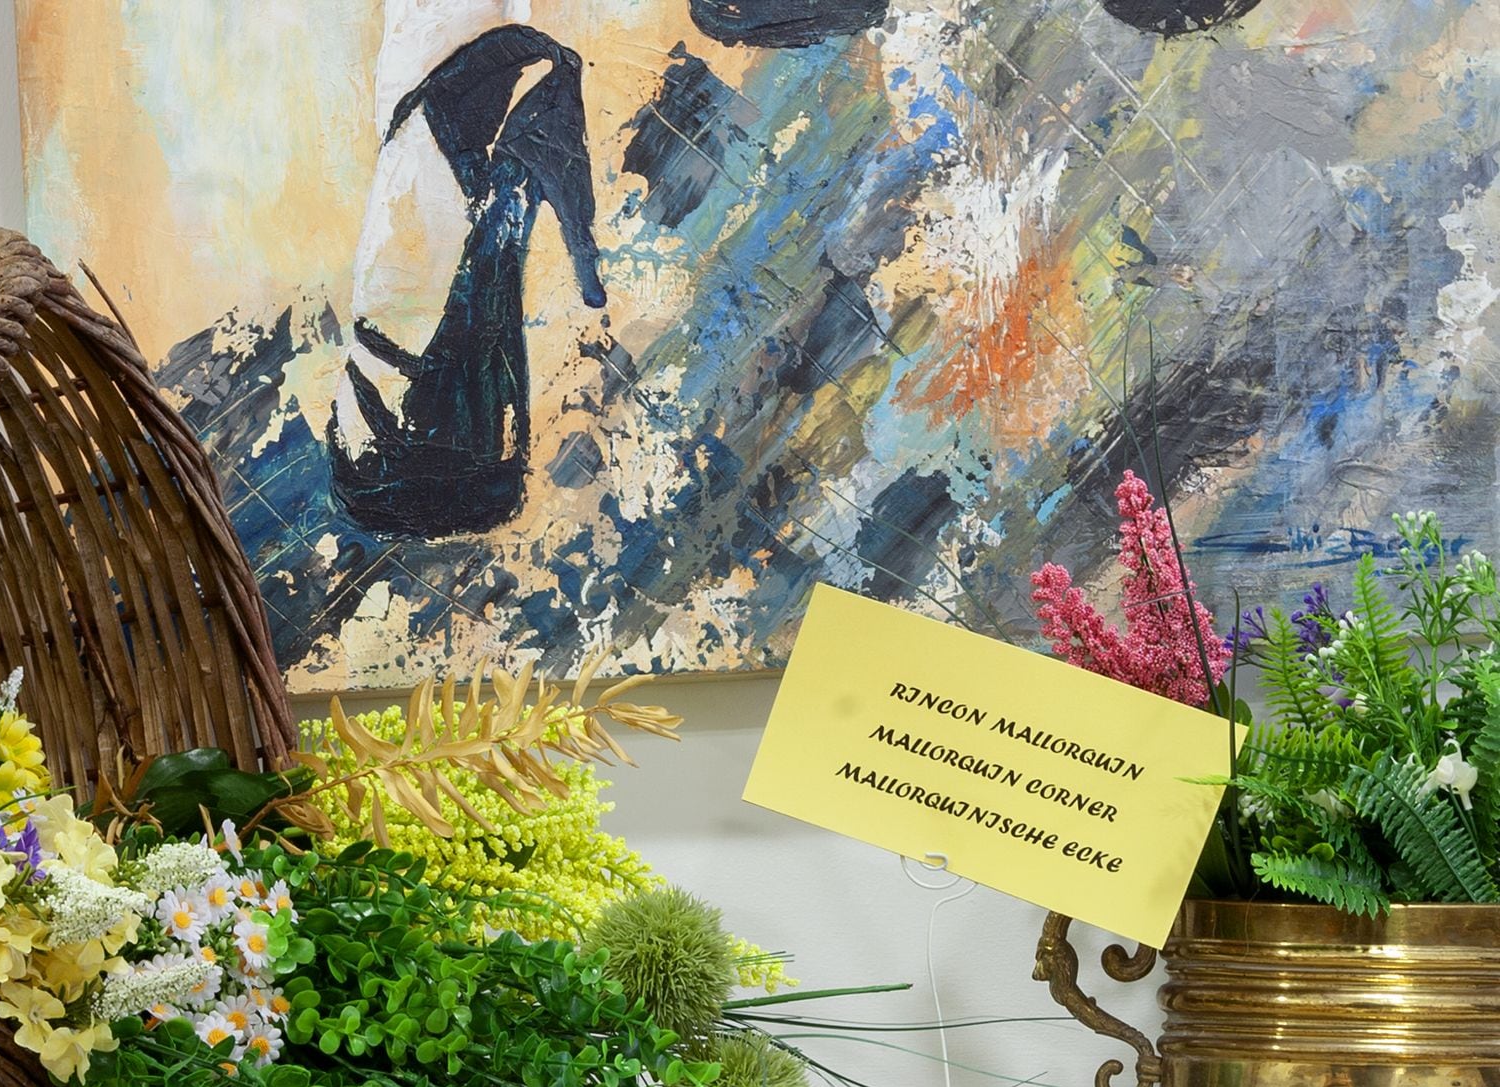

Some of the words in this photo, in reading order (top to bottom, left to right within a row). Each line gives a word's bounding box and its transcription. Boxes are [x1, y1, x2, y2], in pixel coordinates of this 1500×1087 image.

[868, 725, 1023, 787] MALLORQUIN
[1025, 778, 1118, 823] CORNER
[889, 682, 988, 726] RINCON
[989, 717, 1145, 781] MALLORQUIN
[835, 762, 1059, 850] MALLORQUINISCHE
[1061, 840, 1124, 873] ECKE
